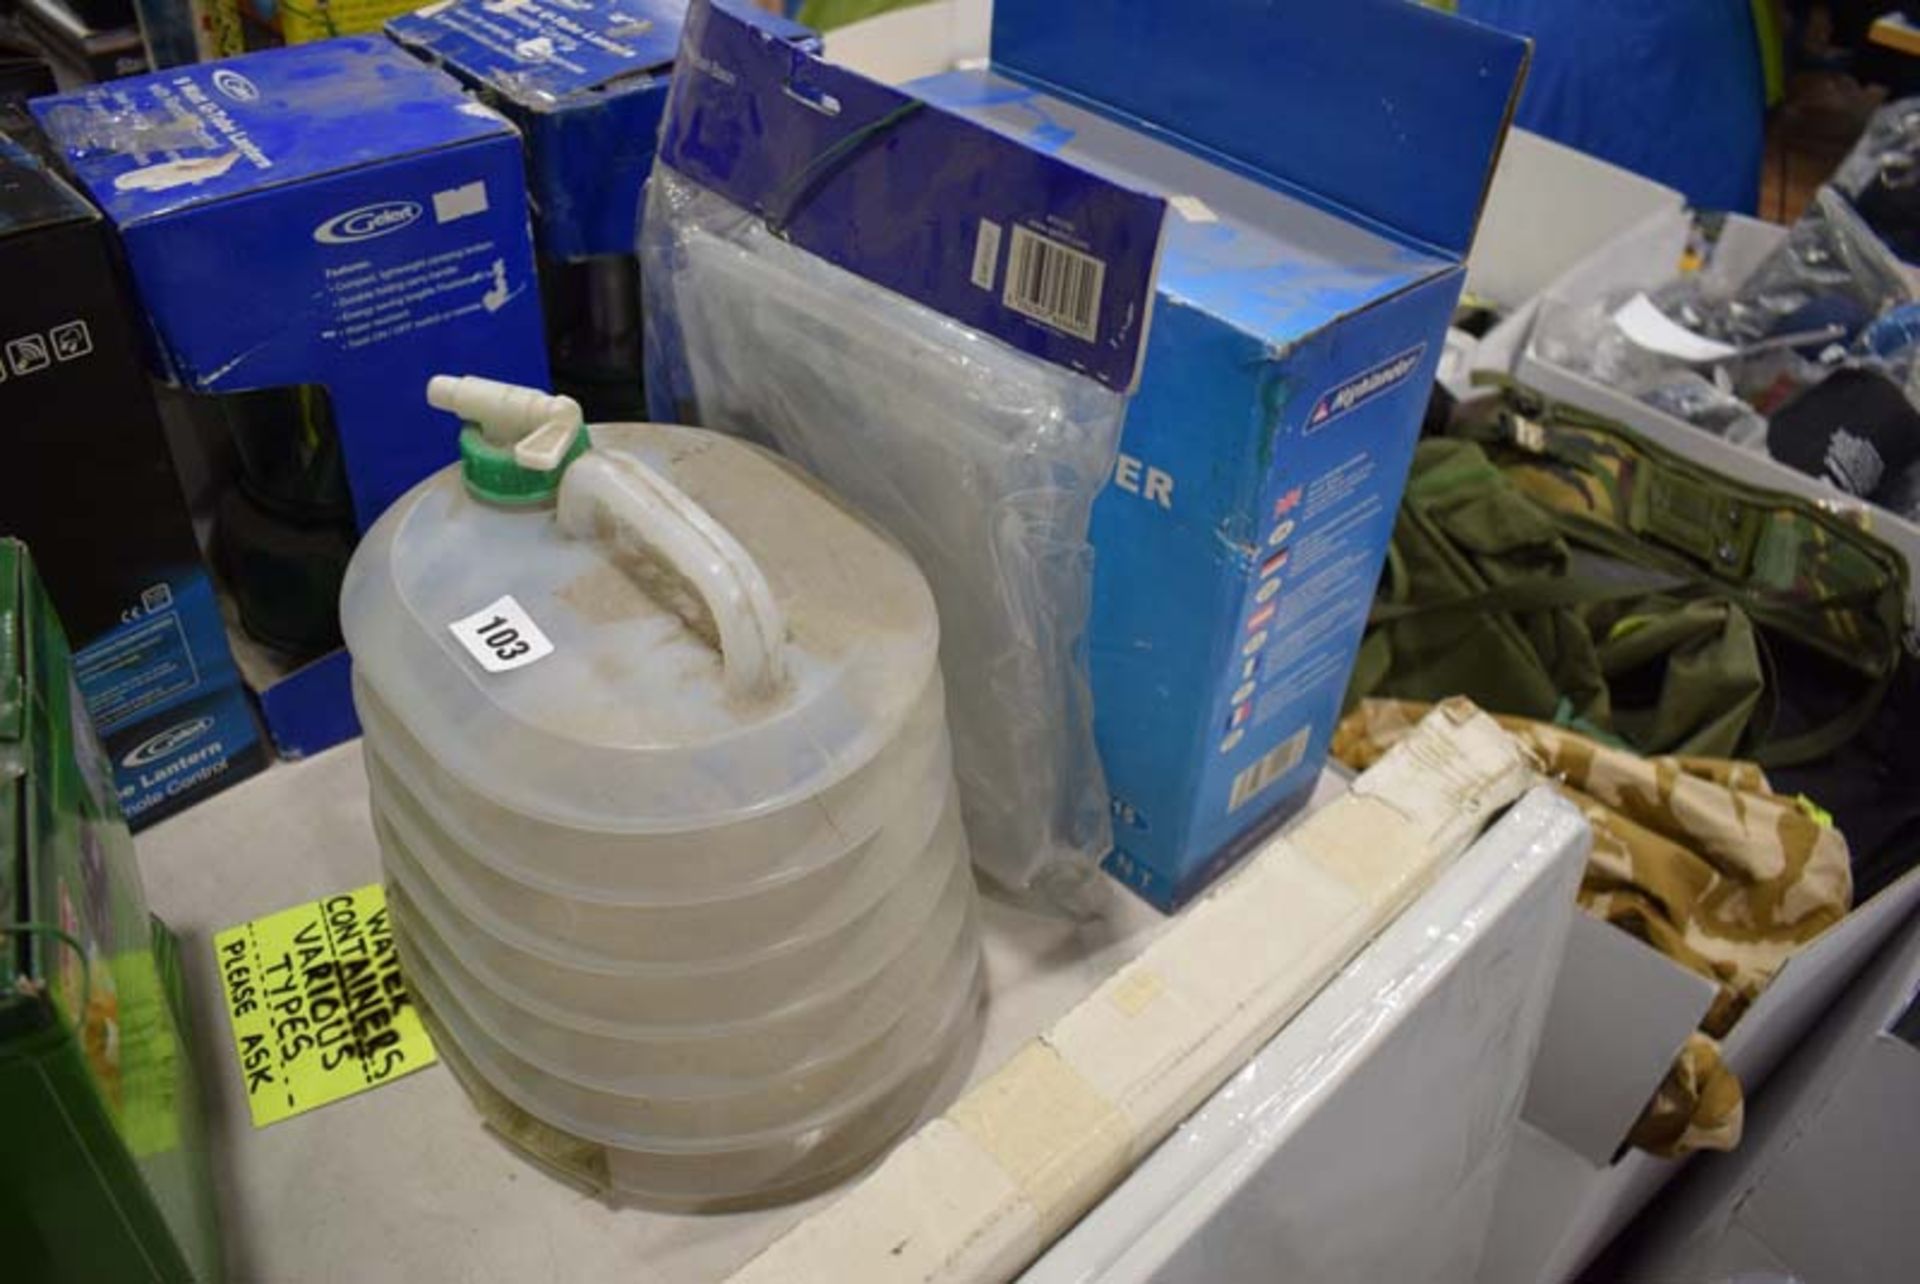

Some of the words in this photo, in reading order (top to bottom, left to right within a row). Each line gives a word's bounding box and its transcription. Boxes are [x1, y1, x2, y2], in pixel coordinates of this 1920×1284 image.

[344, 206, 415, 234] Gelert
[1115, 453, 1173, 510] ER
[476, 615, 531, 661] 103
[140, 741, 223, 788] Lantern
[166, 757, 230, 796] Control
[221, 937, 259, 1019] PLEASE
[265, 952, 315, 1062] TYPES
[293, 920, 354, 1072] VARIOUS
[325, 895, 405, 1080] CONTAINERS
[239, 1033, 275, 1095] ASK
